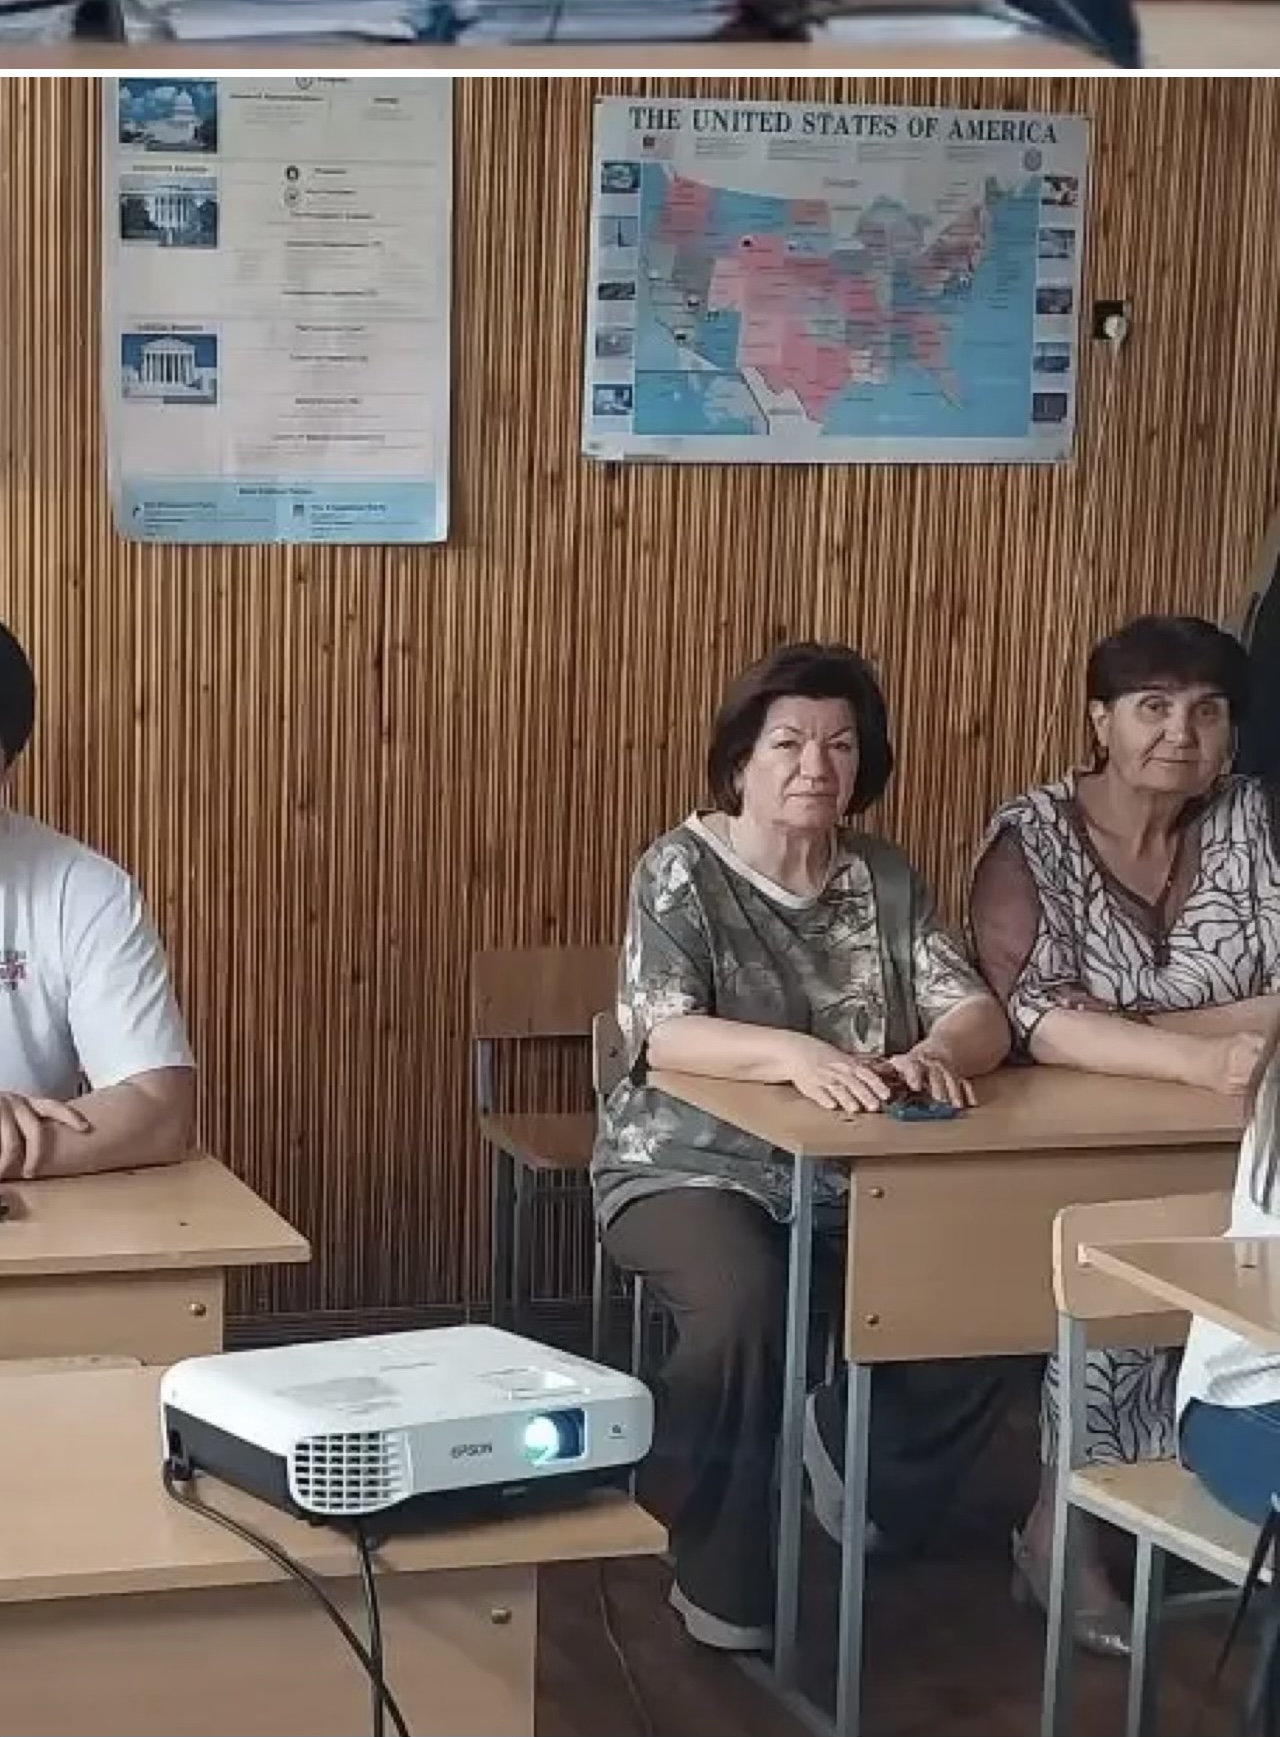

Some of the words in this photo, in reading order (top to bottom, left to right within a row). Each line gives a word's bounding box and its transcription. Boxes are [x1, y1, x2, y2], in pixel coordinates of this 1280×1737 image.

[628, 105, 682, 131] THE
[692, 108, 793, 134] UNITED
[802, 112, 897, 137] STATES
[907, 116, 939, 139] OF
[948, 117, 1058, 144] AMERICA
[450, 1442, 493, 1460] EPSON
